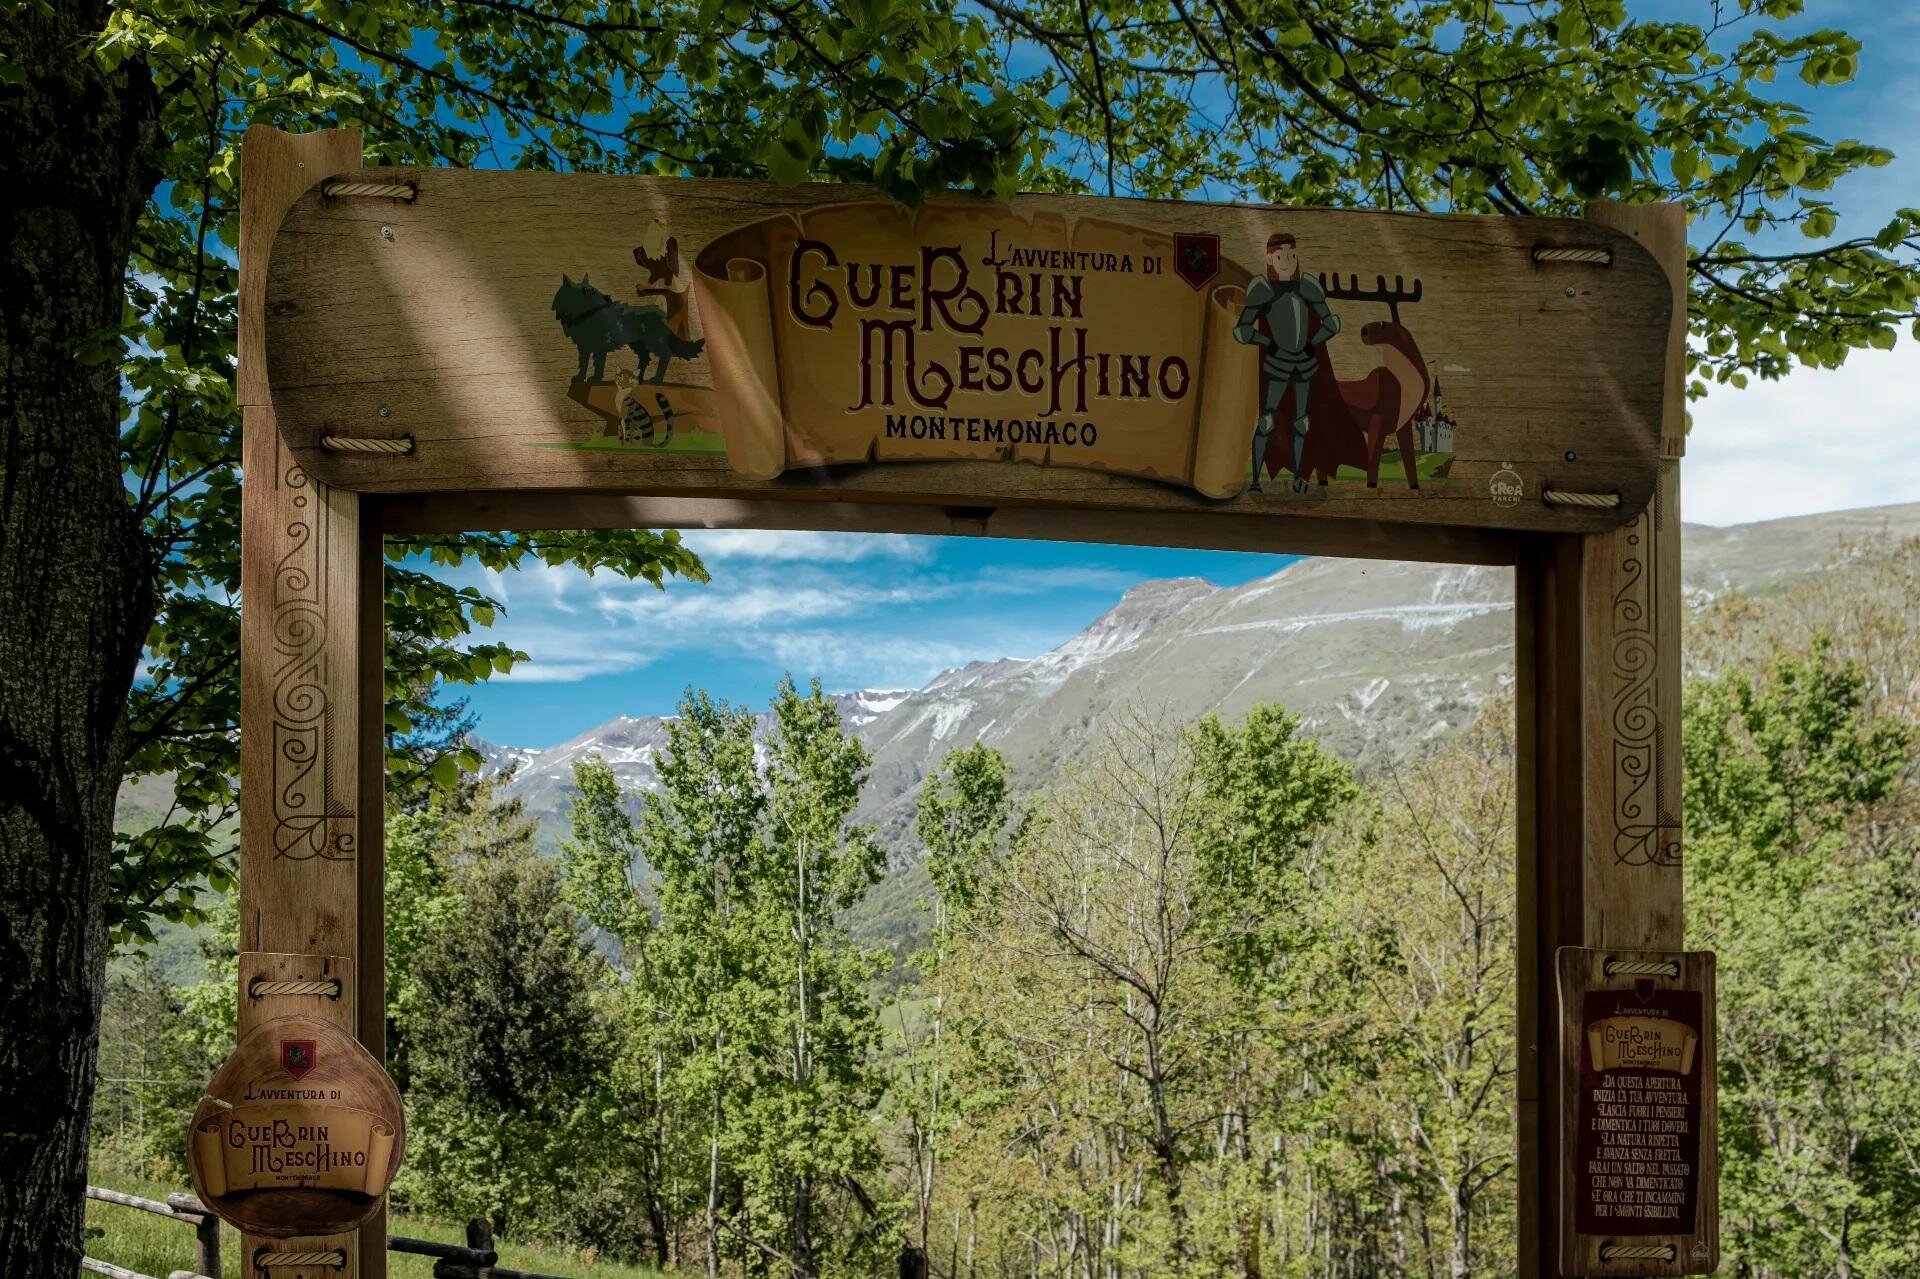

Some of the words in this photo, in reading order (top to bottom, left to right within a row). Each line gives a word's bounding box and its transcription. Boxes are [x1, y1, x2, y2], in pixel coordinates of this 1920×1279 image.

[1143, 256, 1162, 275] DI
[886, 415, 1097, 446] MONTEMONACO
[1602, 1074, 1615, 1088] DA
[1617, 1076, 1643, 1089] QUESTA
[1645, 1077, 1681, 1090] APERTURA
[331, 1090, 341, 1100] DI
[1593, 1089, 1616, 1102] INIZIA
[1629, 1091, 1643, 1102] TUA
[1597, 1103, 1626, 1117] LASCIA
[1629, 1105, 1649, 1117] FUORI
[1651, 1106, 1654, 1117] I
[1655, 1106, 1685, 1118] PENSIERI
[1591, 1118, 1597, 1130] E
[1598, 1118, 1637, 1131] DIMENTICA
[1638, 1119, 1642, 1131] I
[1643, 1119, 1660, 1132] TUOI
[1601, 1132, 1615, 1145] LA
[1616, 1133, 1646, 1146] NATURA
[1648, 1134, 1680, 1147] RISPETTA
[1596, 1147, 1602, 1159] E
[1602, 1147, 1630, 1160] AVANZA
[1631, 1148, 1653, 1160] SENZA
[1588, 1161, 1609, 1174] FARAI
[1611, 1161, 1622, 1174] UN
[1624, 1162, 1645, 1175] SALTO
[1646, 1163, 1660, 1175] NEL
[1662, 1163, 1690, 1176] PASSATO
[1592, 1175, 1606, 1188] CHE
[1608, 1176, 1623, 1188] NON
[1625, 1176, 1634, 1188] VA
[1602, 1190, 1618, 1202] ORA
[1620, 1190, 1634, 1203] CHE
[1636, 1191, 1643, 1203] TI
[1595, 1205, 1608, 1217] PER
[1609, 1205, 1613, 1217] I
